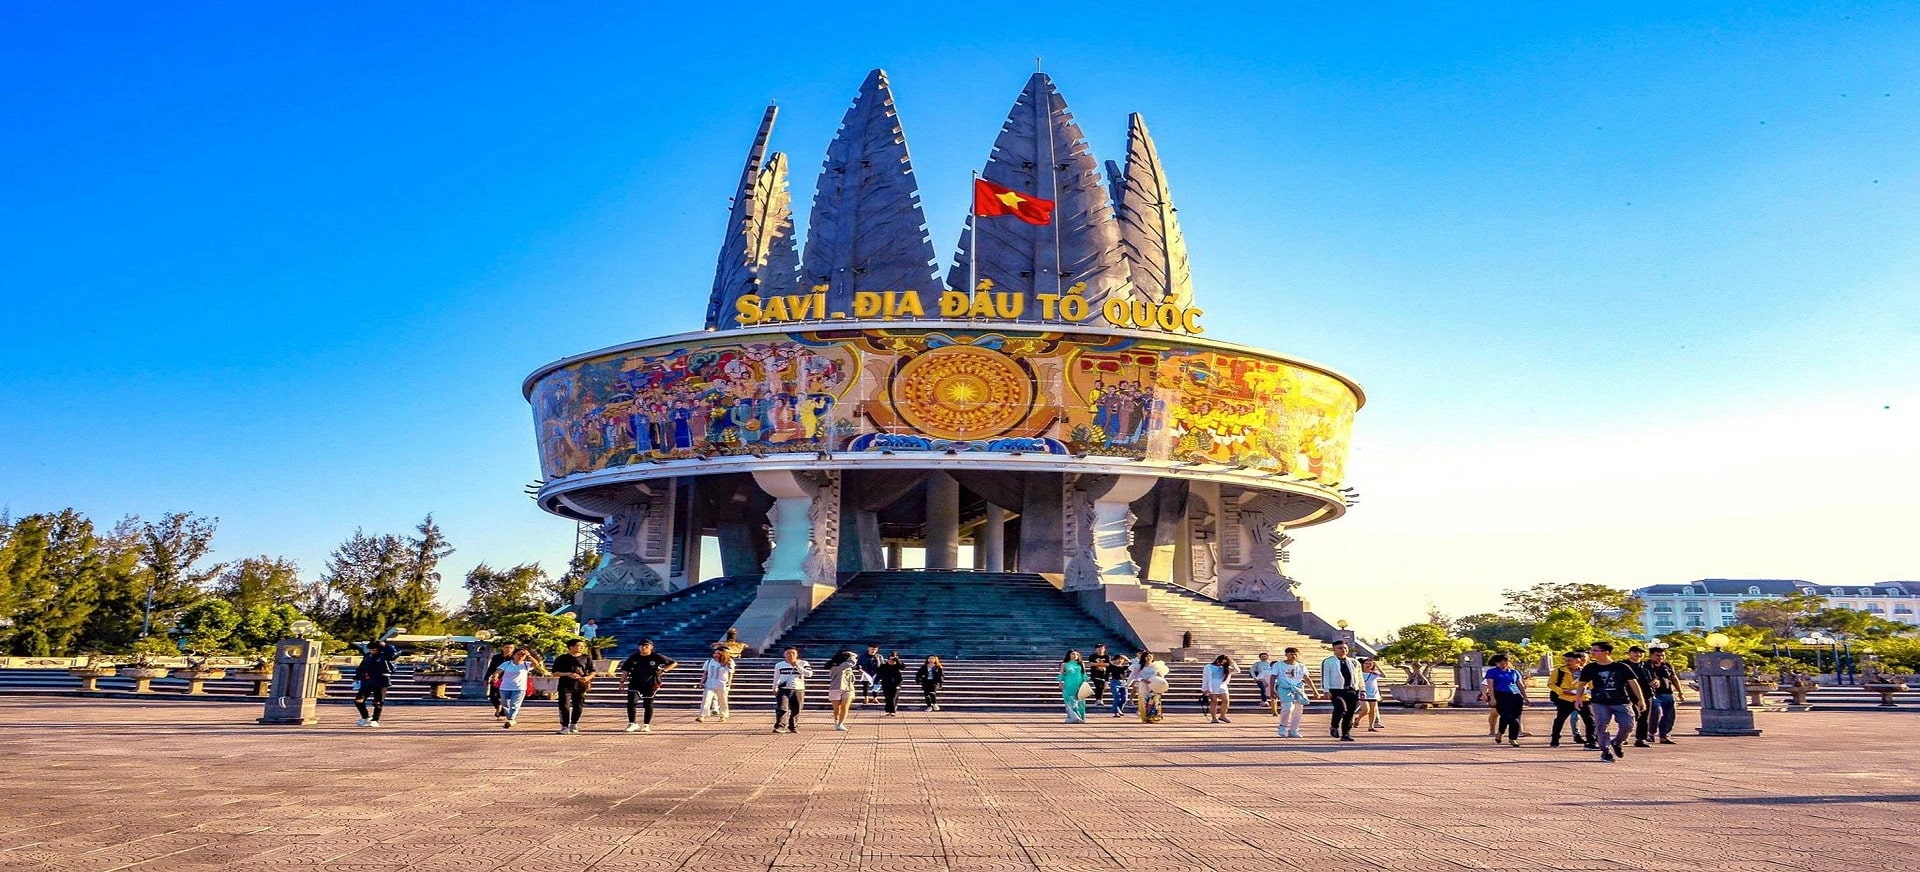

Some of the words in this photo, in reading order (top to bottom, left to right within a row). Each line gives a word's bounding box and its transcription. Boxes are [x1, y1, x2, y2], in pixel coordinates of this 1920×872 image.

[851, 290, 924, 321] ĐỊA
[1036, 281, 1090, 322] TỔ
[1103, 293, 1204, 334] QUỐC
